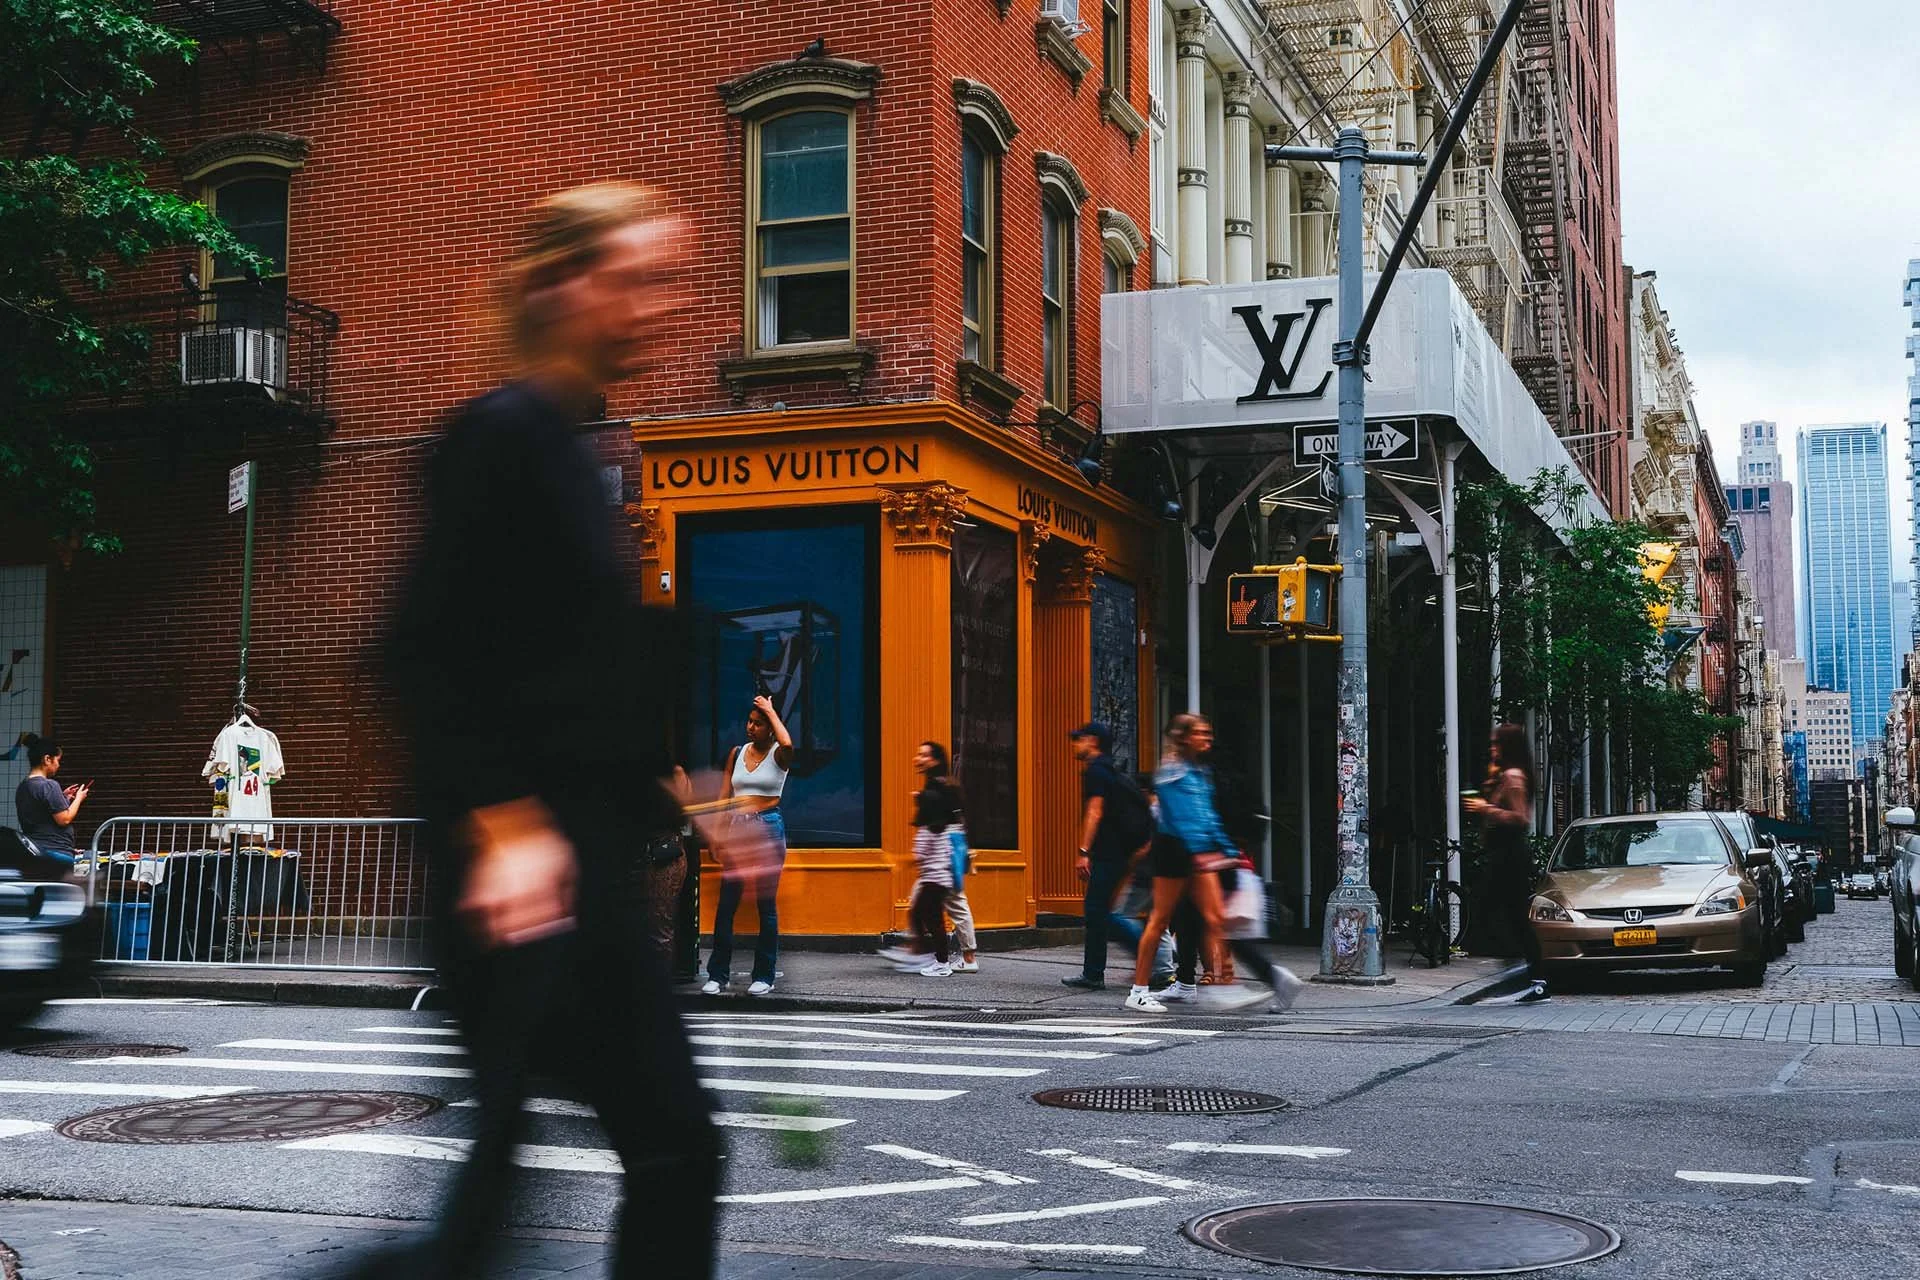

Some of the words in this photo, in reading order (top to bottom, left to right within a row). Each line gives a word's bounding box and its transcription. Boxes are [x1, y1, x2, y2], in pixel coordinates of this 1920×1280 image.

[652, 455, 751, 490] LOUIS
[764, 443, 920, 482] VUITTON
[1311, 436, 1340, 453] ON
[1017, 484, 1051, 524] LOUIS
[1053, 501, 1097, 545] VUITTON
